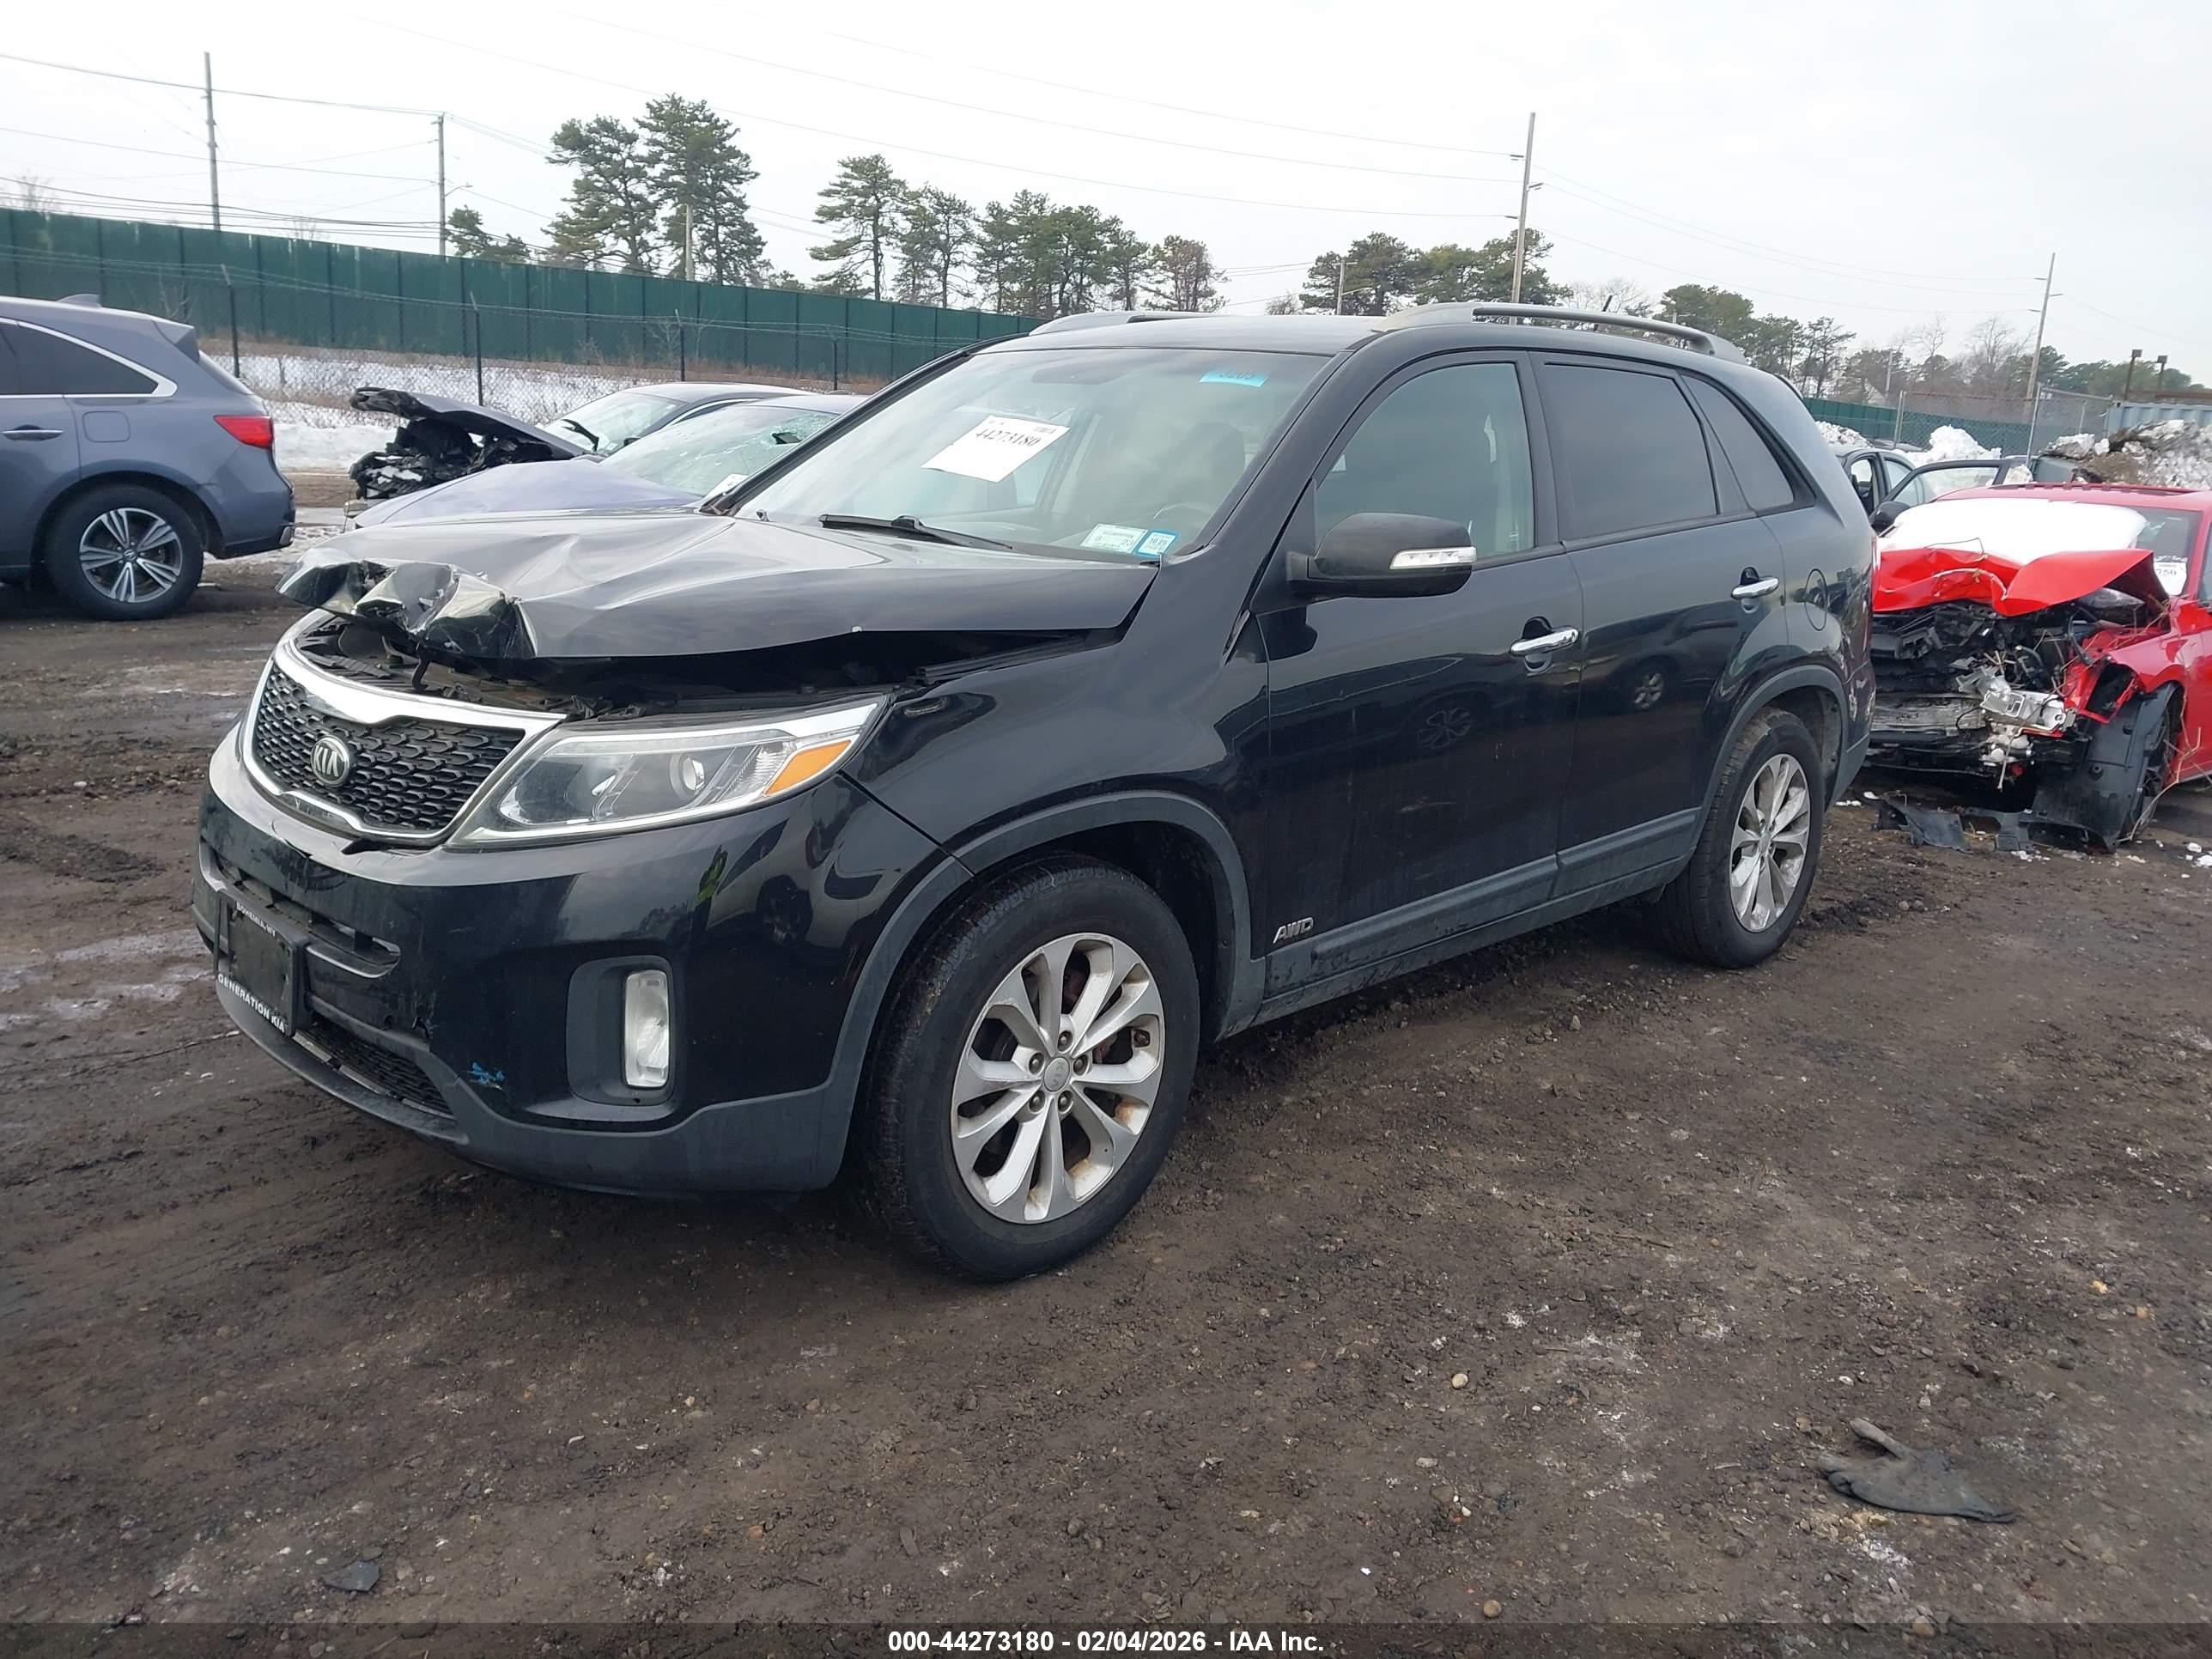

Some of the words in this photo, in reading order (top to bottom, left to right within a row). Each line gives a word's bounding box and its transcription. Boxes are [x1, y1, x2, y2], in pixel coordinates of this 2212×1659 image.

[975, 428, 1042, 447] 44273180
[313, 744, 339, 777] KIA
[1273, 916, 1314, 944] AWD
[217, 973, 270, 1020] GENERATION
[270, 1015, 285, 1034] KIA
